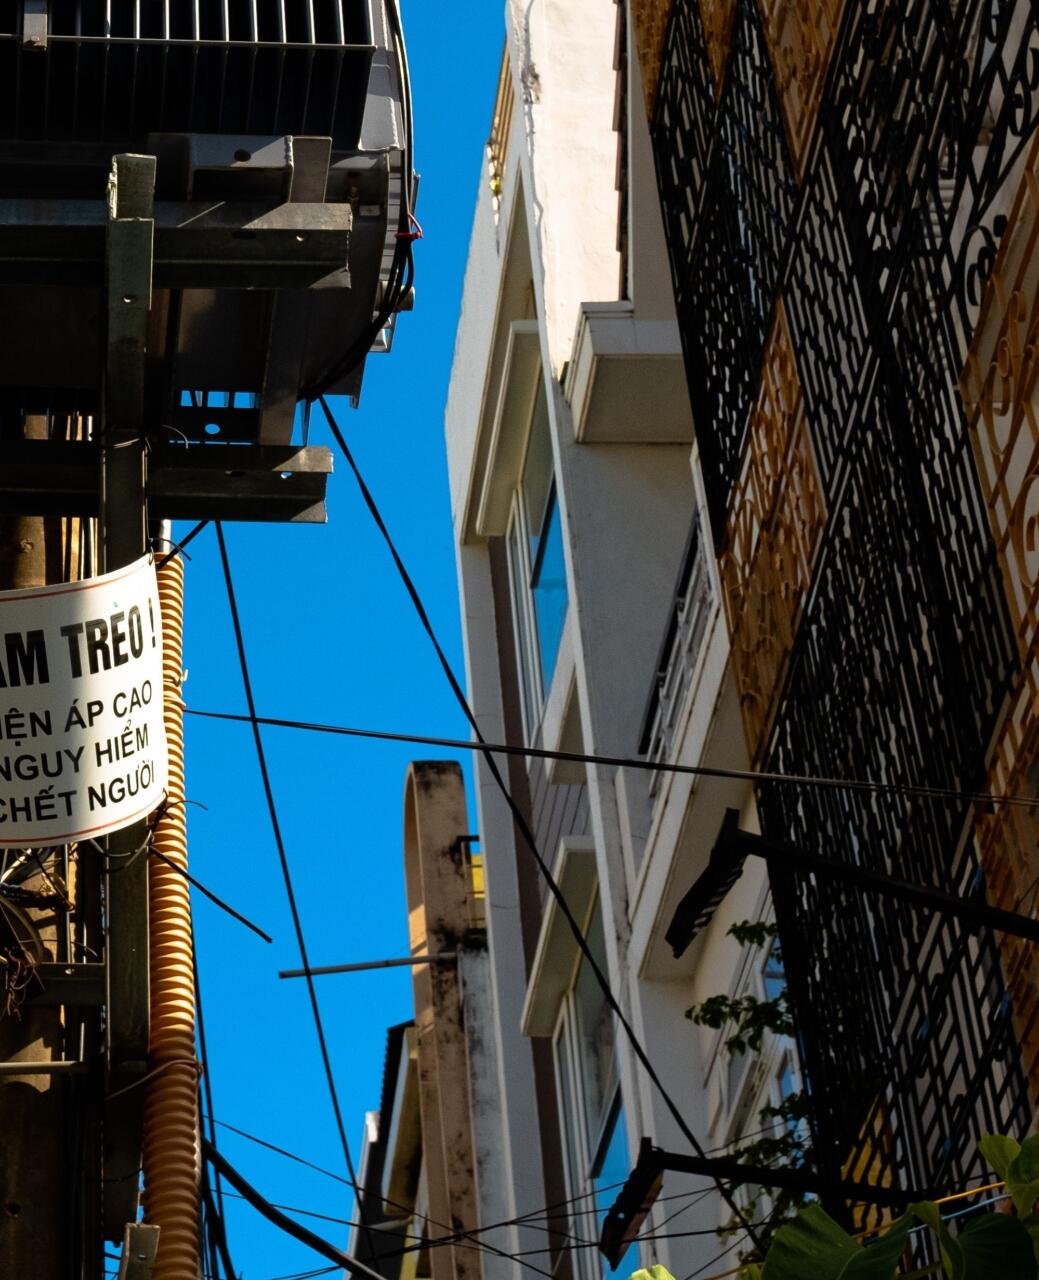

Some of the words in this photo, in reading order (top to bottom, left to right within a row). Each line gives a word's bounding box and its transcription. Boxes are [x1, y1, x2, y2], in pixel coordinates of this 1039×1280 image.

[64, 698, 104, 732] ÁP
[113, 680, 152, 718] CAO
[95, 718, 148, 768] HIỂM
[87, 759, 154, 811] NGƯỜI
